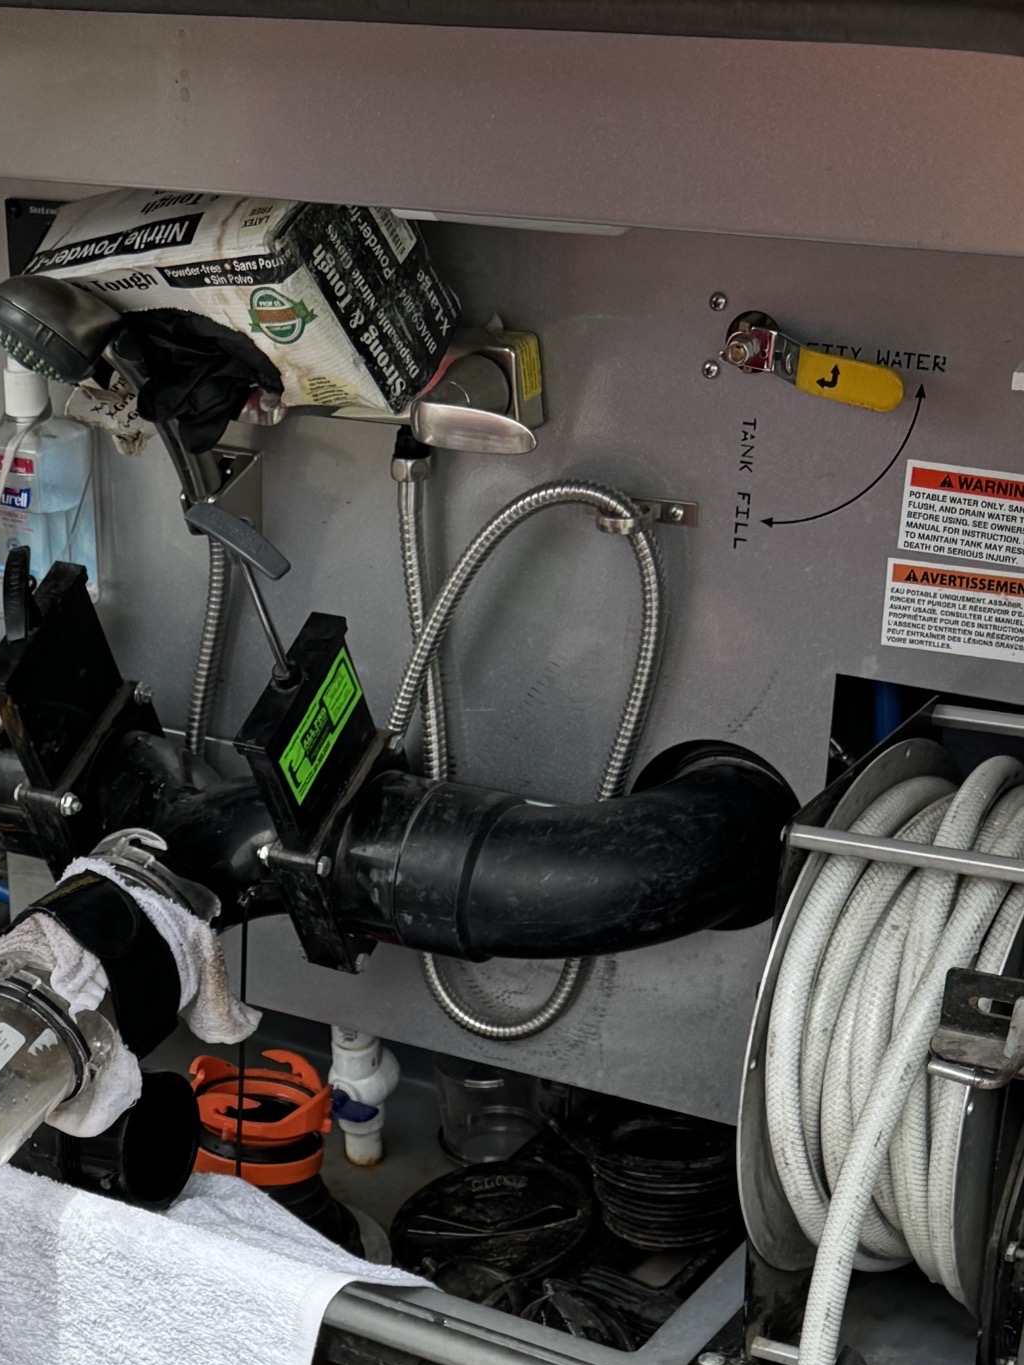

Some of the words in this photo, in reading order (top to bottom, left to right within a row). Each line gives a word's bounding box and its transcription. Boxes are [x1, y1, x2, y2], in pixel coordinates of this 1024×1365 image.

[242, 215, 271, 229] LATEX
[248, 205, 274, 217] FREE
[125, 220, 190, 250] Nitrile
[326, 224, 353, 270] Gloves
[163, 264, 223, 279] Powder-free
[232, 259, 257, 273] Sans
[228, 274, 254, 286] Polvo
[312, 243, 353, 313] Tough
[93, 271, 160, 292] Tough
[351, 268, 378, 311] Nitrile
[416, 269, 451, 336] X-Large
[349, 308, 365, 329] &
[375, 307, 420, 379] Disposable
[360, 325, 407, 397] Strong
[876, 349, 947, 374] WATER
[738, 418, 757, 473] TANK
[957, 476, 1024, 498] WARNIN
[908, 501, 936, 512] FLUSH,
[938, 505, 957, 514] AND
[959, 508, 985, 519] DRAIN
[987, 513, 1017, 523] WATER
[909, 490, 947, 502] POTABLE
[949, 496, 978, 507] WATER
[981, 501, 1005, 511] ONLY.
[1008, 505, 1024, 515] SAN
[733, 491, 751, 549] FILL
[907, 511, 940, 523] BEFORE
[942, 516, 970, 527] USING.
[972, 520, 989, 529] SEE
[905, 531, 916, 539] TO
[917, 532, 957, 545] MAINTAIN
[960, 539, 982, 549] TANK
[984, 543, 1003, 553] MAY
[1005, 546, 1024, 556] RES
[906, 521, 940, 533] MANUAL
[942, 526, 960, 535] FOR
[962, 529, 1021, 545] INSTRUCTION.
[903, 541, 931, 551] DEATH
[933, 545, 945, 553] OR
[947, 547, 984, 559] SERIOUS
[985, 552, 1018, 565] INJURY.
[906, 589, 938, 599] POTABLE
[920, 571, 1024, 595] AVERTISSEMEN
[889, 603, 911, 612] AVANT
[940, 610, 982, 620] CONSULTER
[888, 619, 926, 630] L'ABSENCE
[939, 618, 959, 626] POUR
[977, 623, 1024, 635] INSTRUCTION
[886, 636, 907, 644] VOIRE
